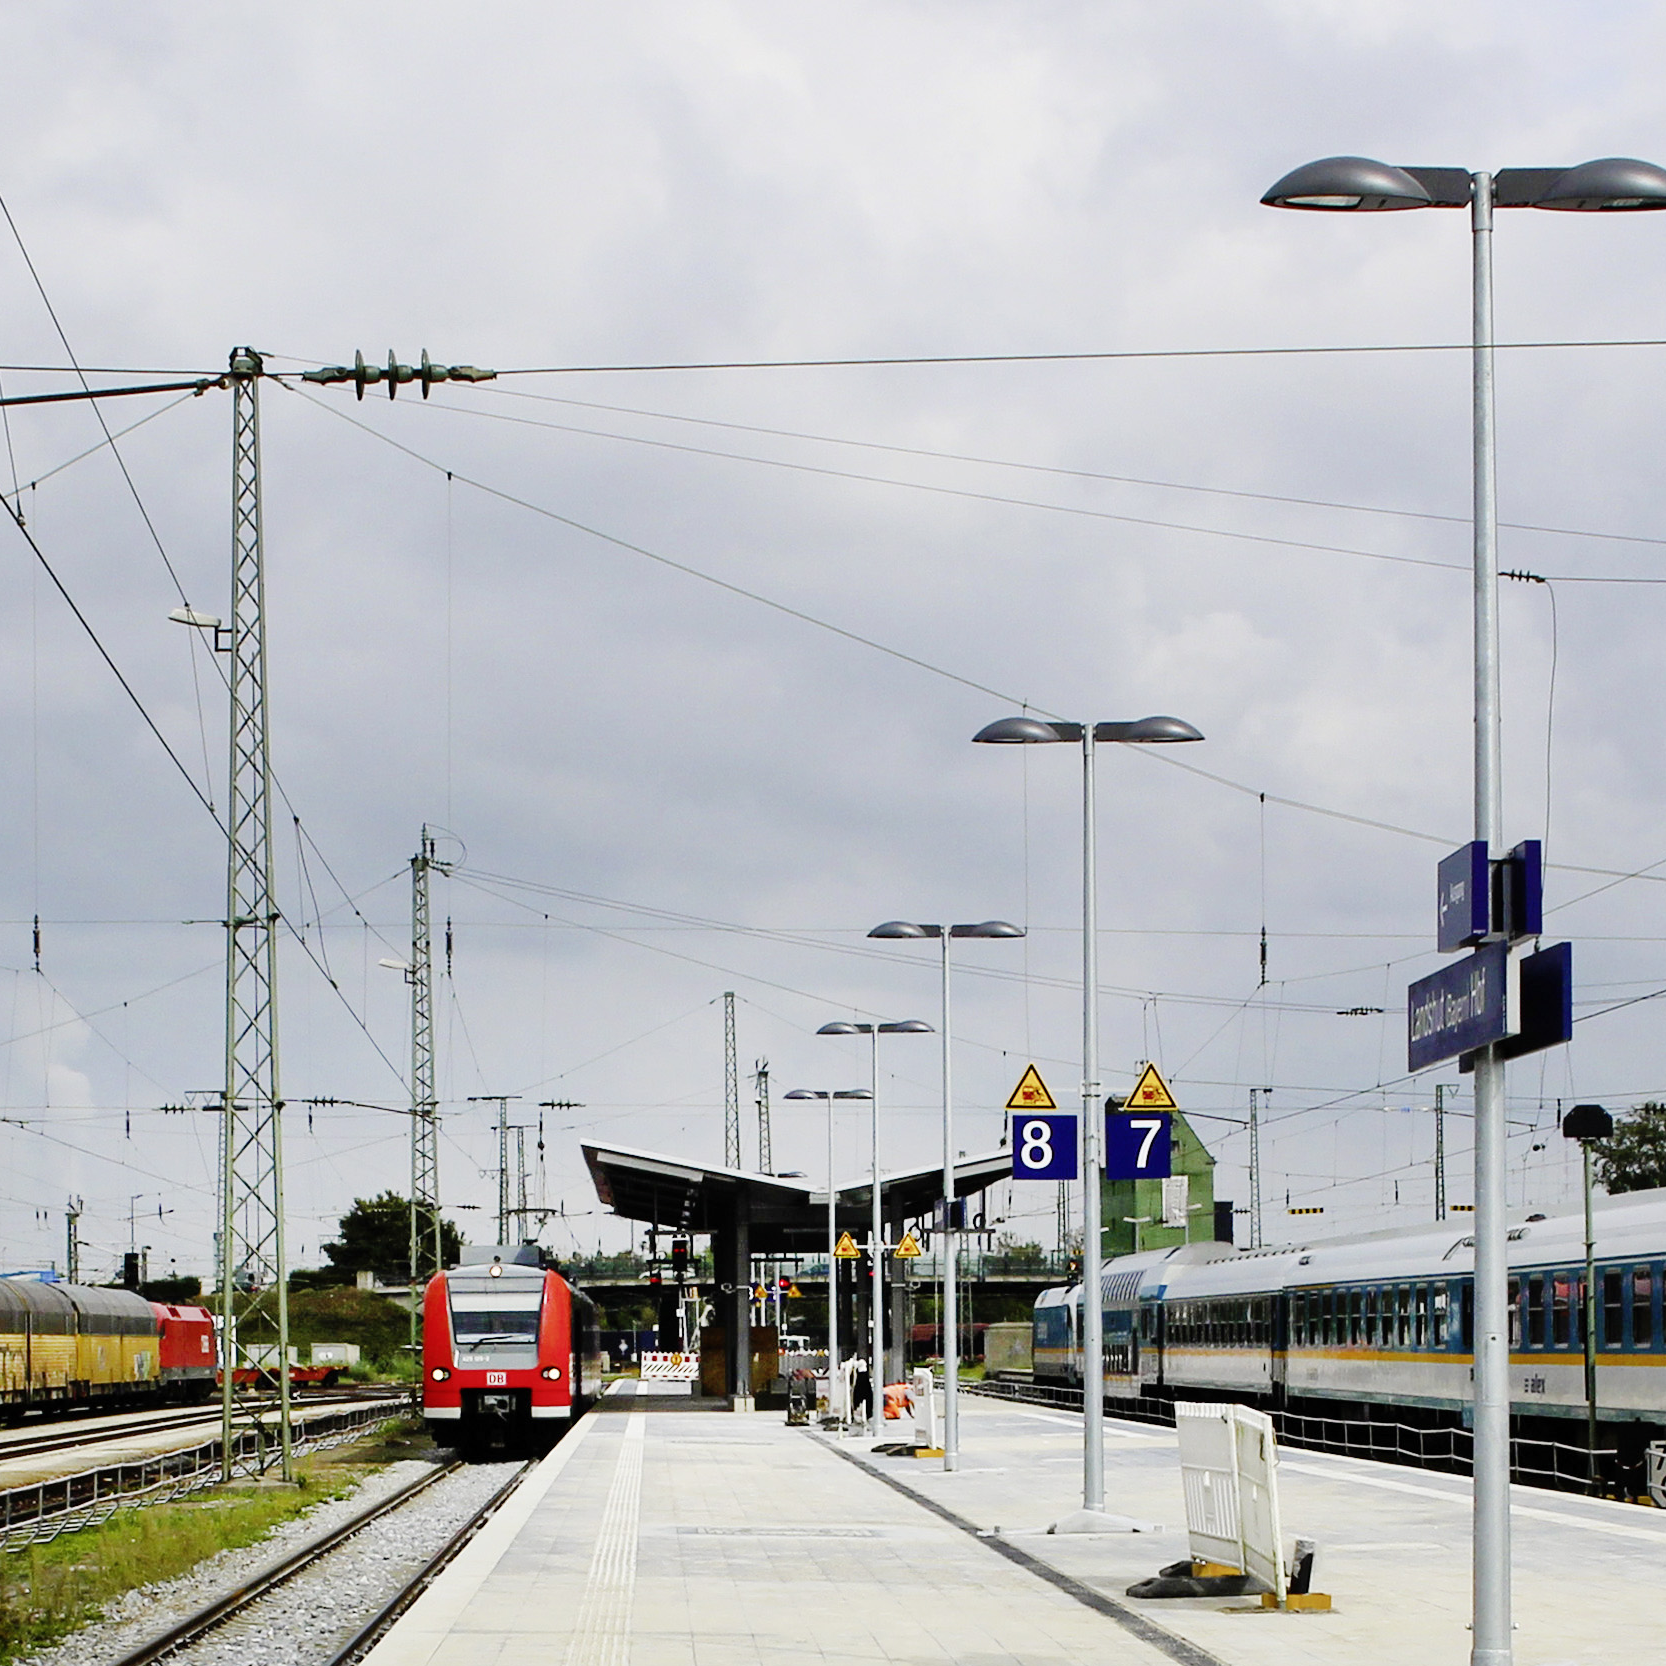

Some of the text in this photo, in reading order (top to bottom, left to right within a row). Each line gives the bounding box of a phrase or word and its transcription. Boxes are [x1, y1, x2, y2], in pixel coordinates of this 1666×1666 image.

[1020, 1120, 1053, 1170] 8
[1130, 1120, 1162, 1169] 7
[489, 1373, 504, 1384] DB
